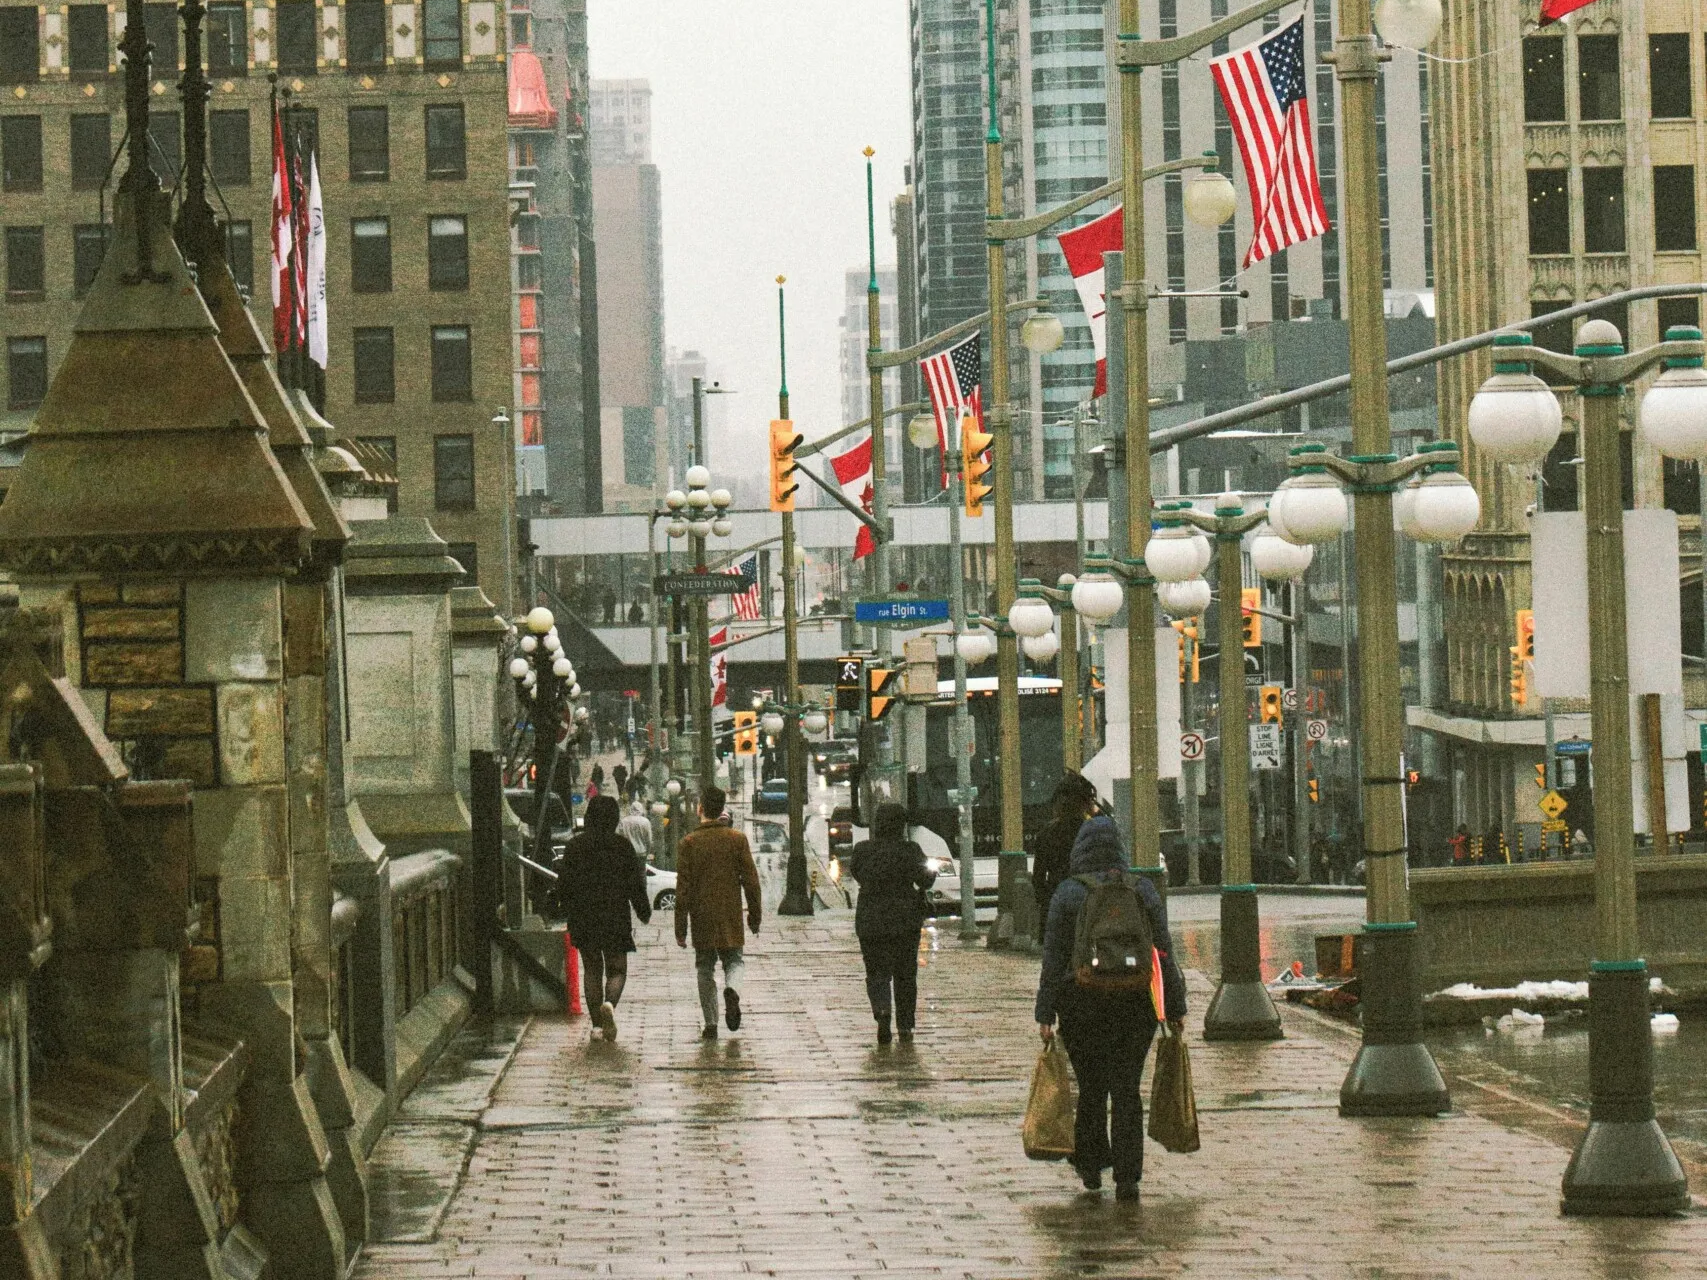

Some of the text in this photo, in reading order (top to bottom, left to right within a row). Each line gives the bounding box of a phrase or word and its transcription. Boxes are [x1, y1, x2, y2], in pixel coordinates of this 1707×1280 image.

[664, 579, 739, 592] CONFEDERATION
[878, 609, 890, 617] rue
[892, 603, 916, 618] Elgin
[1256, 741, 1273, 749] LIGNE
